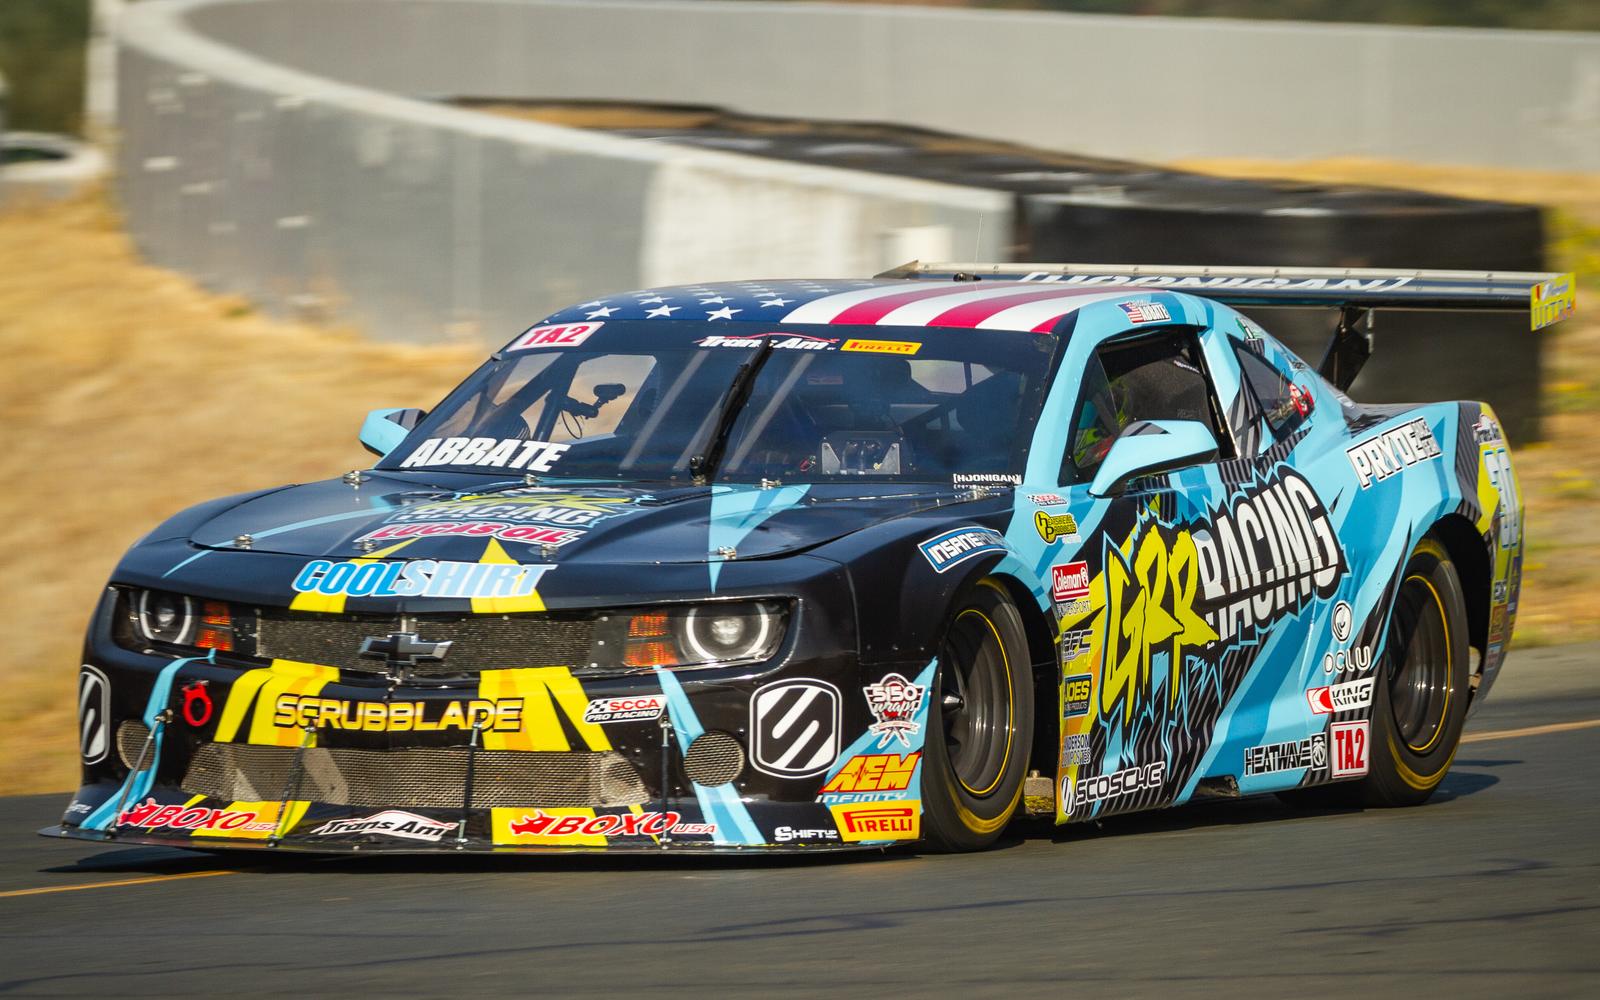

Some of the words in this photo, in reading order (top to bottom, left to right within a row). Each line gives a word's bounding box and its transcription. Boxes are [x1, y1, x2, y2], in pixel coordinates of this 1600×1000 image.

[523, 326, 590, 346] TA2
[772, 337, 829, 350] Am
[850, 341, 911, 352] PIRELLI
[400, 437, 571, 472] ABBATE
[1347, 421, 1428, 488] PRYDE
[371, 523, 498, 540] LUCAS
[501, 527, 570, 545] OIL
[1191, 475, 1339, 650] RACING
[293, 560, 558, 597] COOLSHIRT
[1053, 567, 1082, 593] Coleman
[1323, 645, 1371, 676] OCLU
[609, 699, 659, 711] SCCA
[872, 685, 918, 702] 5150
[1332, 683, 1371, 706] KING
[273, 694, 523, 732] SCRUBBLADE
[586, 713, 611, 722] PRO
[612, 709, 659, 719] RACING
[1245, 740, 1312, 776] HEATWAVE
[1335, 728, 1365, 770] TA2
[817, 752, 922, 793] AEM
[1076, 762, 1164, 805] SCOSCHE
[815, 792, 907, 803] INFINITY
[144, 806, 256, 830] BOXO
[324, 821, 394, 833] Trans
[394, 821, 445, 835] Am
[548, 812, 679, 836] BOXO
[673, 824, 716, 834] USA
[842, 808, 913, 833] PIRELLI
